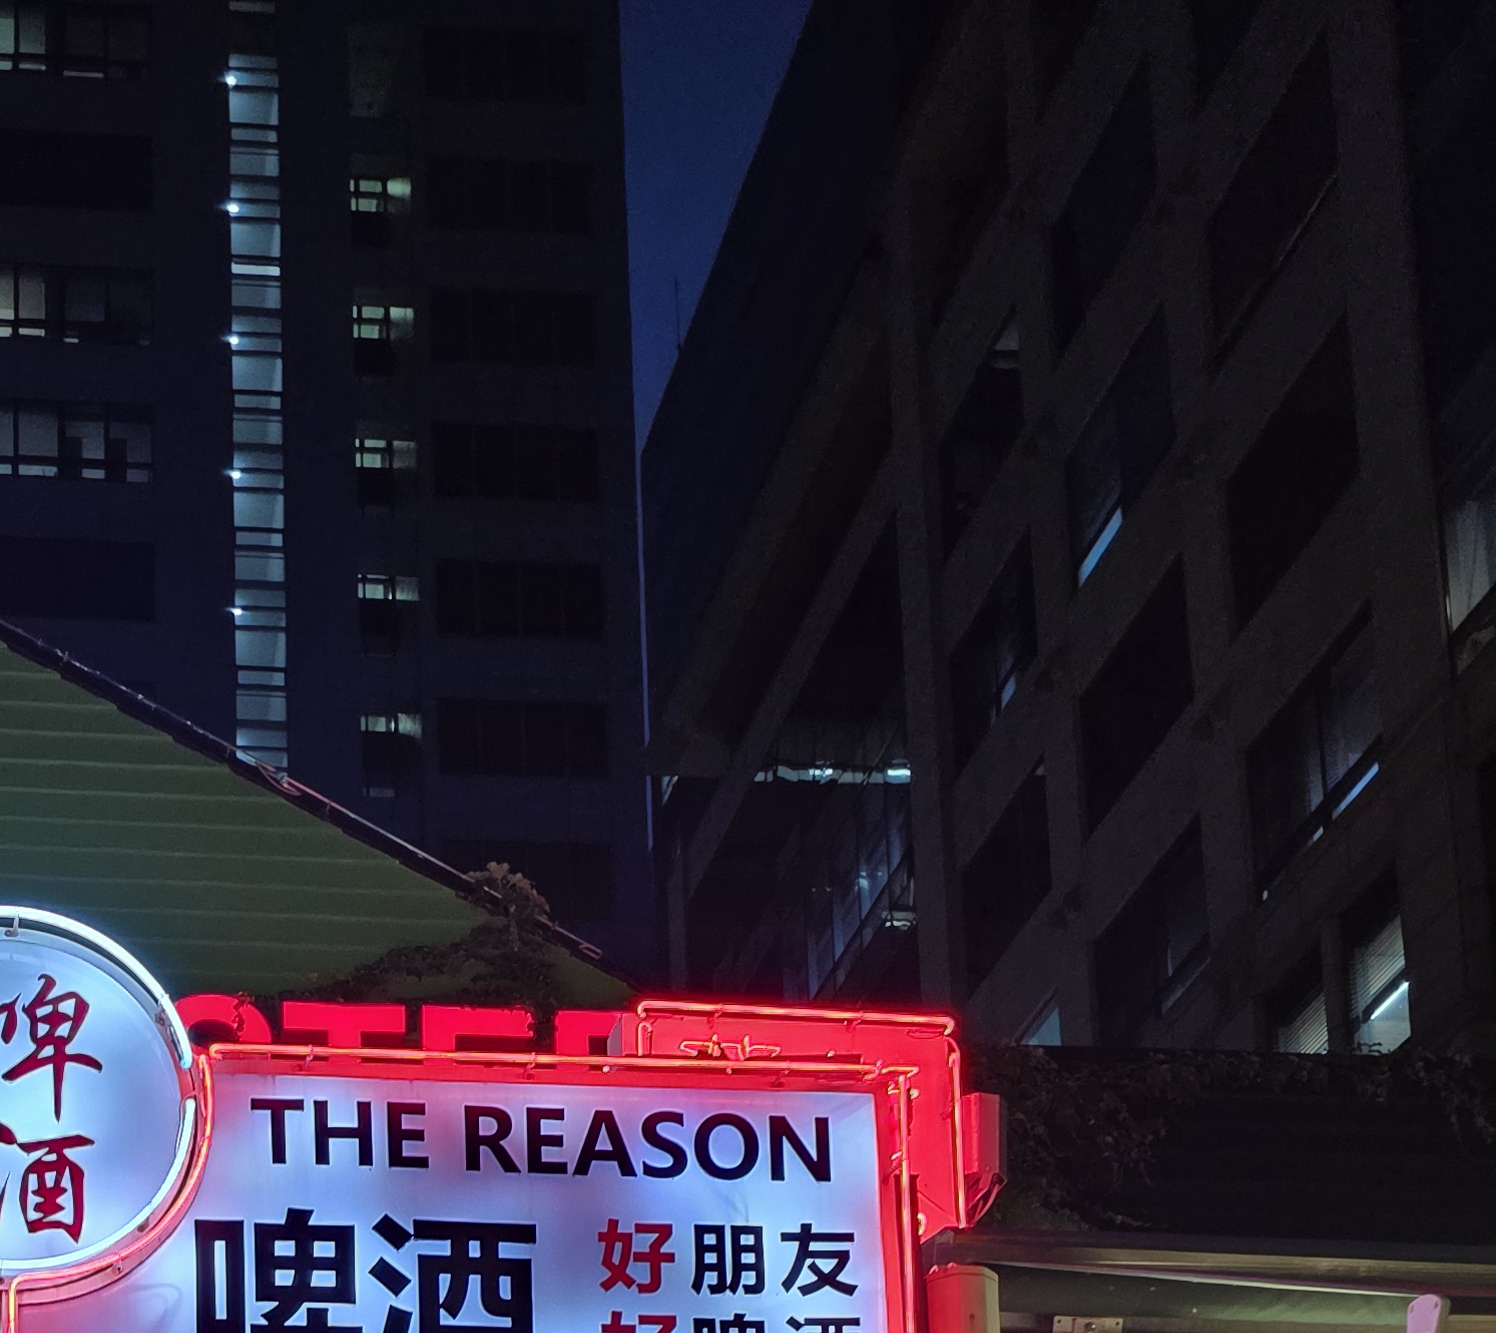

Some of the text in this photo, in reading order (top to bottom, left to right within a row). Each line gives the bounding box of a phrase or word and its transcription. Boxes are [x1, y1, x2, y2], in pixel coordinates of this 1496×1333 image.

[250, 1098, 832, 1182] THE REASON
[597, 1218, 859, 1298] 好朋友
